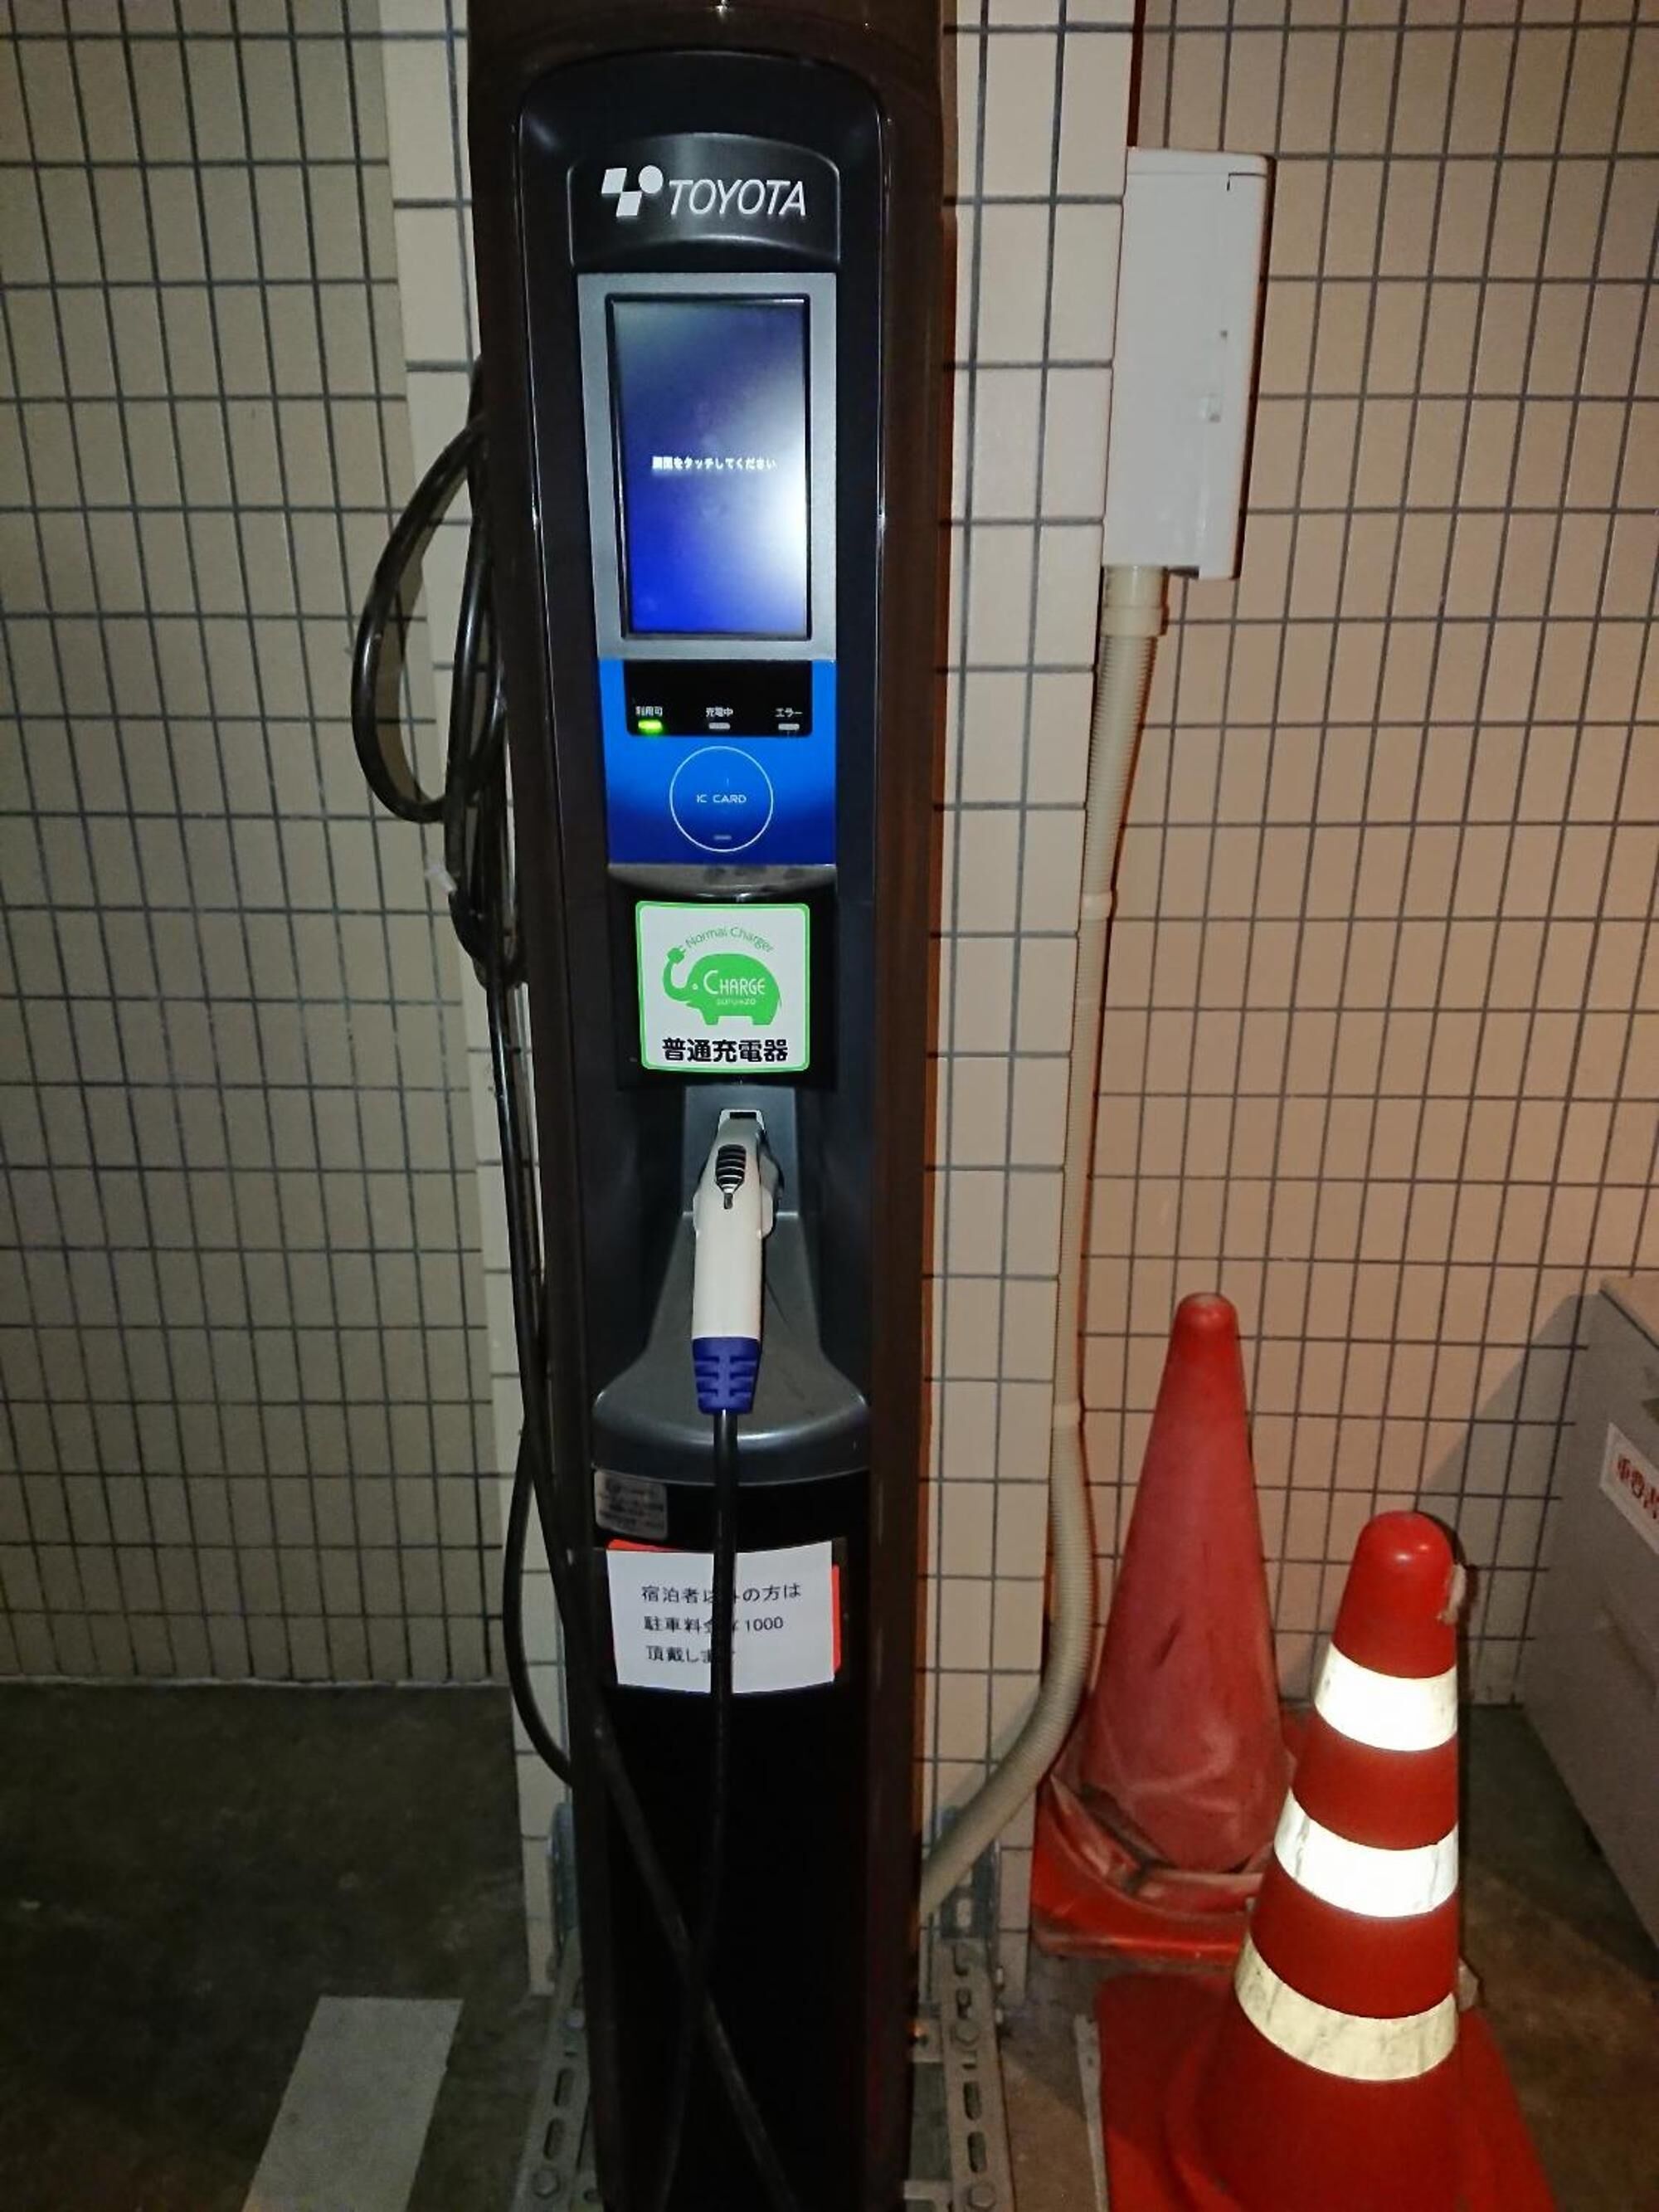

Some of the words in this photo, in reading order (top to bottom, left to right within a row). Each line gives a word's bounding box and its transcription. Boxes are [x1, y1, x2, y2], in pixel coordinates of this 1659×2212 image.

[669, 179, 806, 216] TOYOTA
[706, 708, 733, 718] 充電中
[776, 708, 803, 718] エラー
[697, 794, 708, 803] IC
[713, 794, 747, 803] CARD
[685, 927, 727, 948] Normal
[730, 927, 774, 953] Charger
[703, 970, 766, 995] CHARGE
[662, 1037, 788, 1062] 普通充電器
[641, 1583, 802, 1604] 宿泊者以の方は
